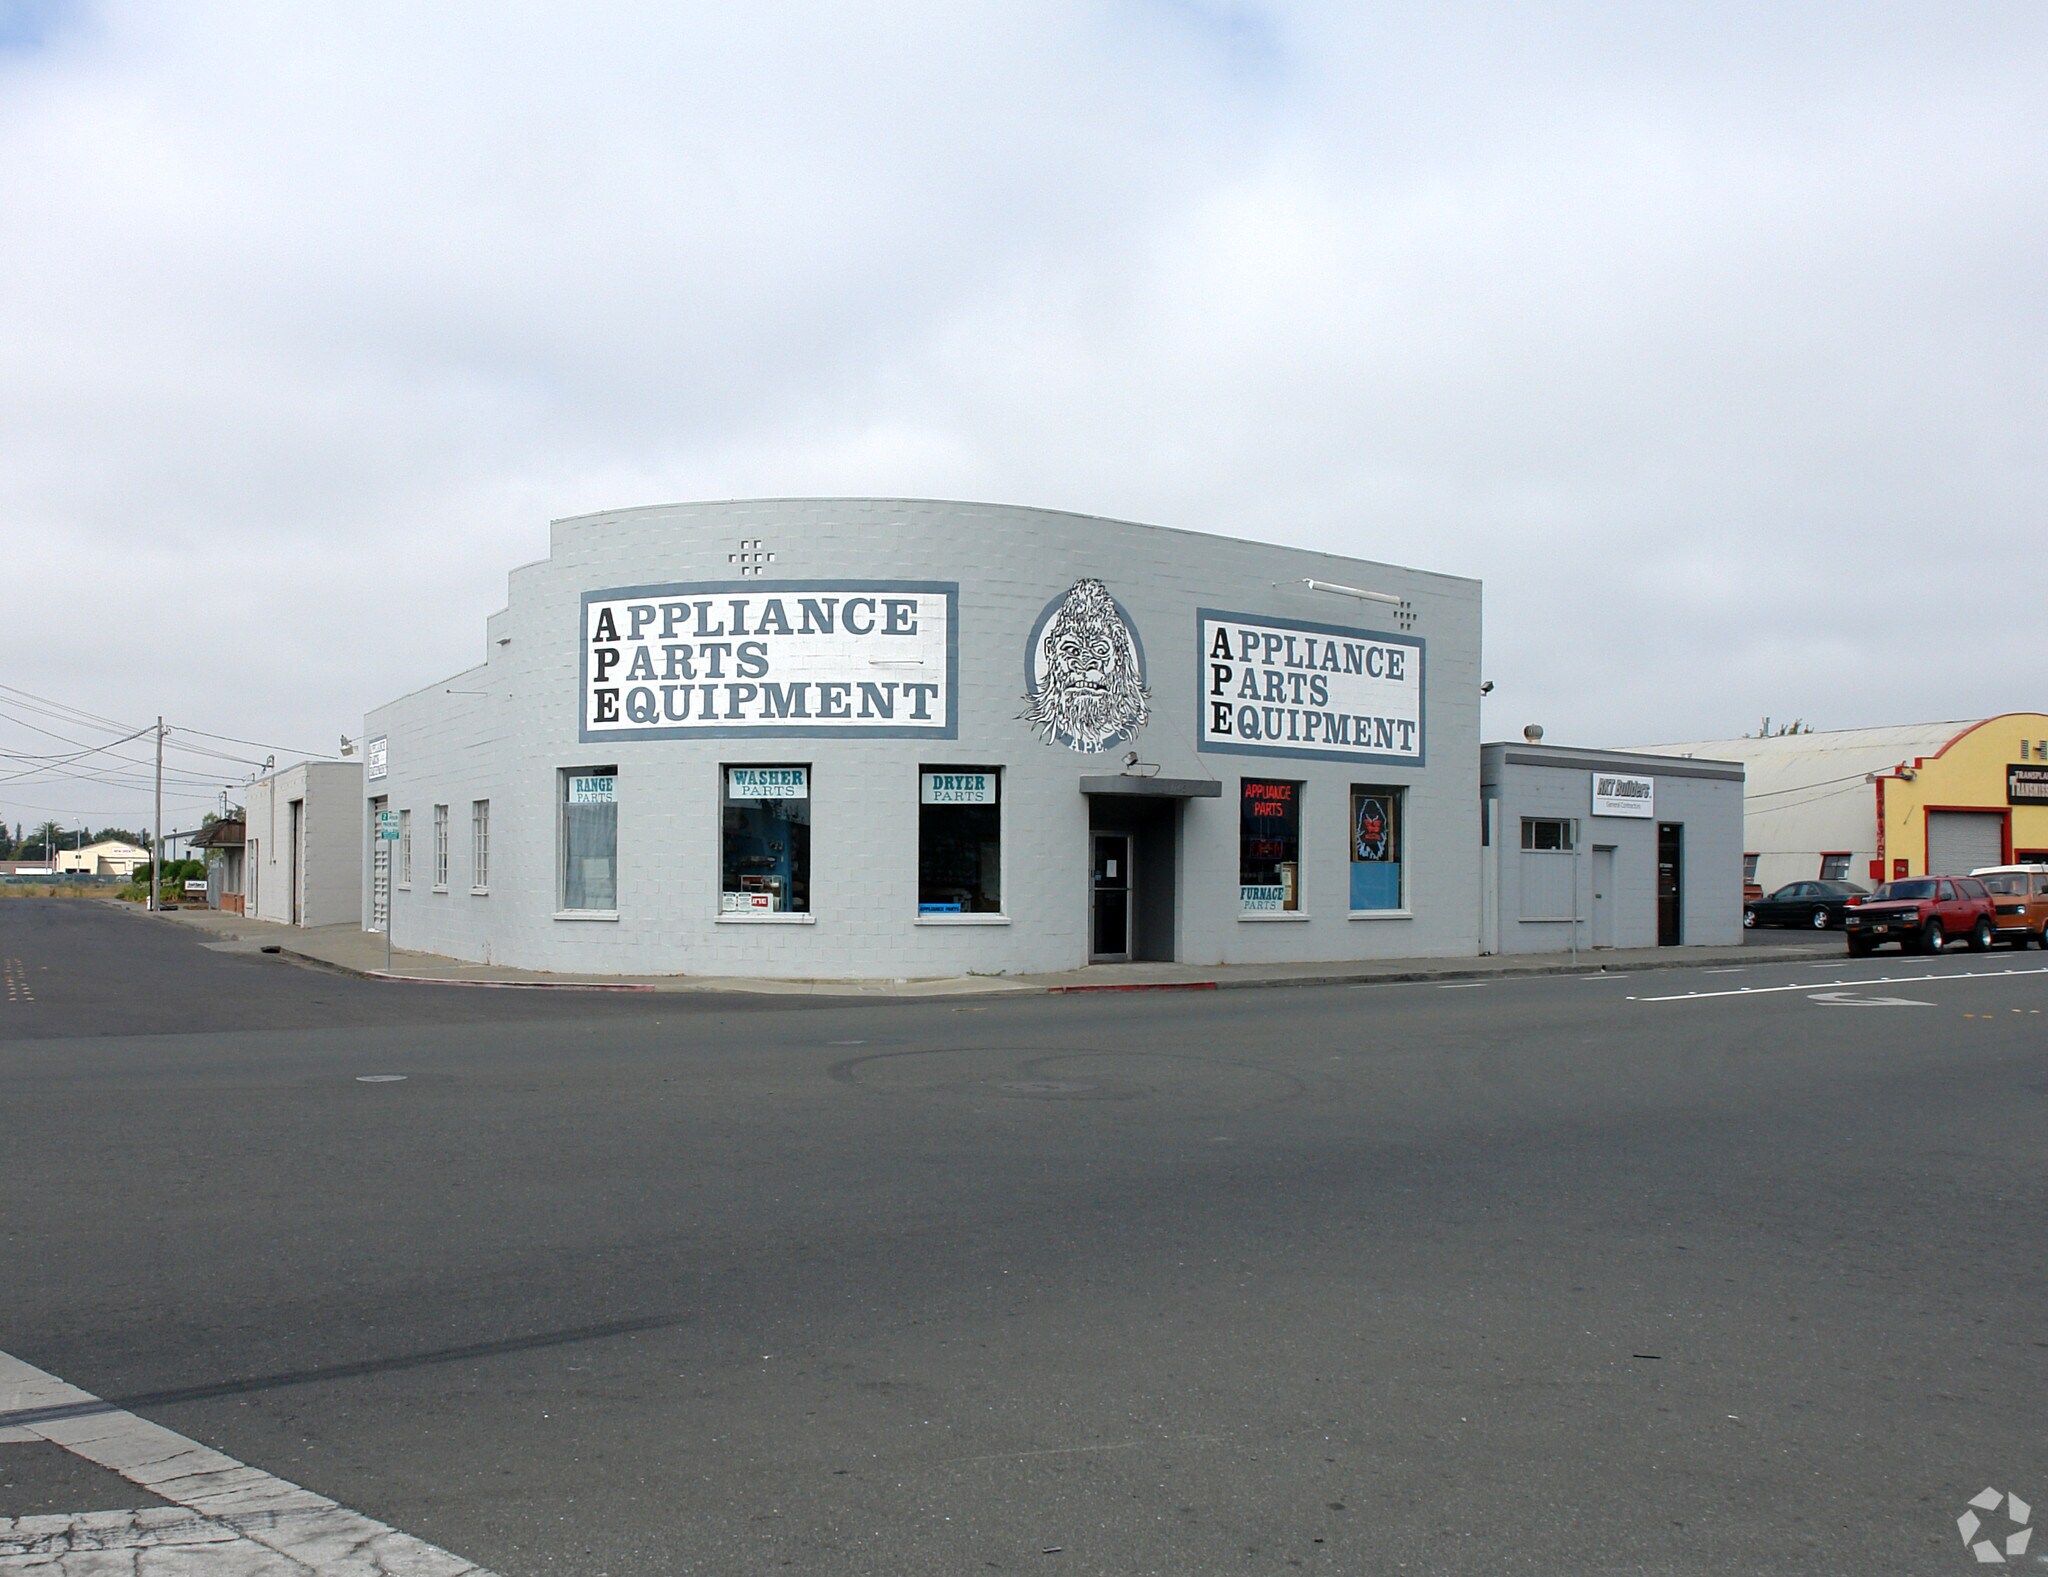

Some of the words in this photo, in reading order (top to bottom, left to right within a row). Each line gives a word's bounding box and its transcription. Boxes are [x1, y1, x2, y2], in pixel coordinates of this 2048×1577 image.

[592, 598, 918, 643] APPLIANCE
[593, 641, 770, 683] PARTS
[1210, 627, 1405, 681] APPLIANCE
[1210, 663, 1329, 707] PARTS
[593, 682, 939, 725] EQUIPMENT
[1210, 701, 1416, 752] EQUIPMENT
[576, 777, 614, 793] RANGE
[733, 770, 804, 786] WASHER
[932, 775, 986, 791] DRYER
[577, 792, 613, 804] PARTS
[742, 785, 795, 796] PARTS
[933, 790, 985, 802] PARTS
[1244, 783, 1292, 801] APPLIANCE
[1254, 801, 1284, 817] PARTS
[1240, 886, 1284, 901] FURNACE
[1244, 900, 1277, 910] PARTS
